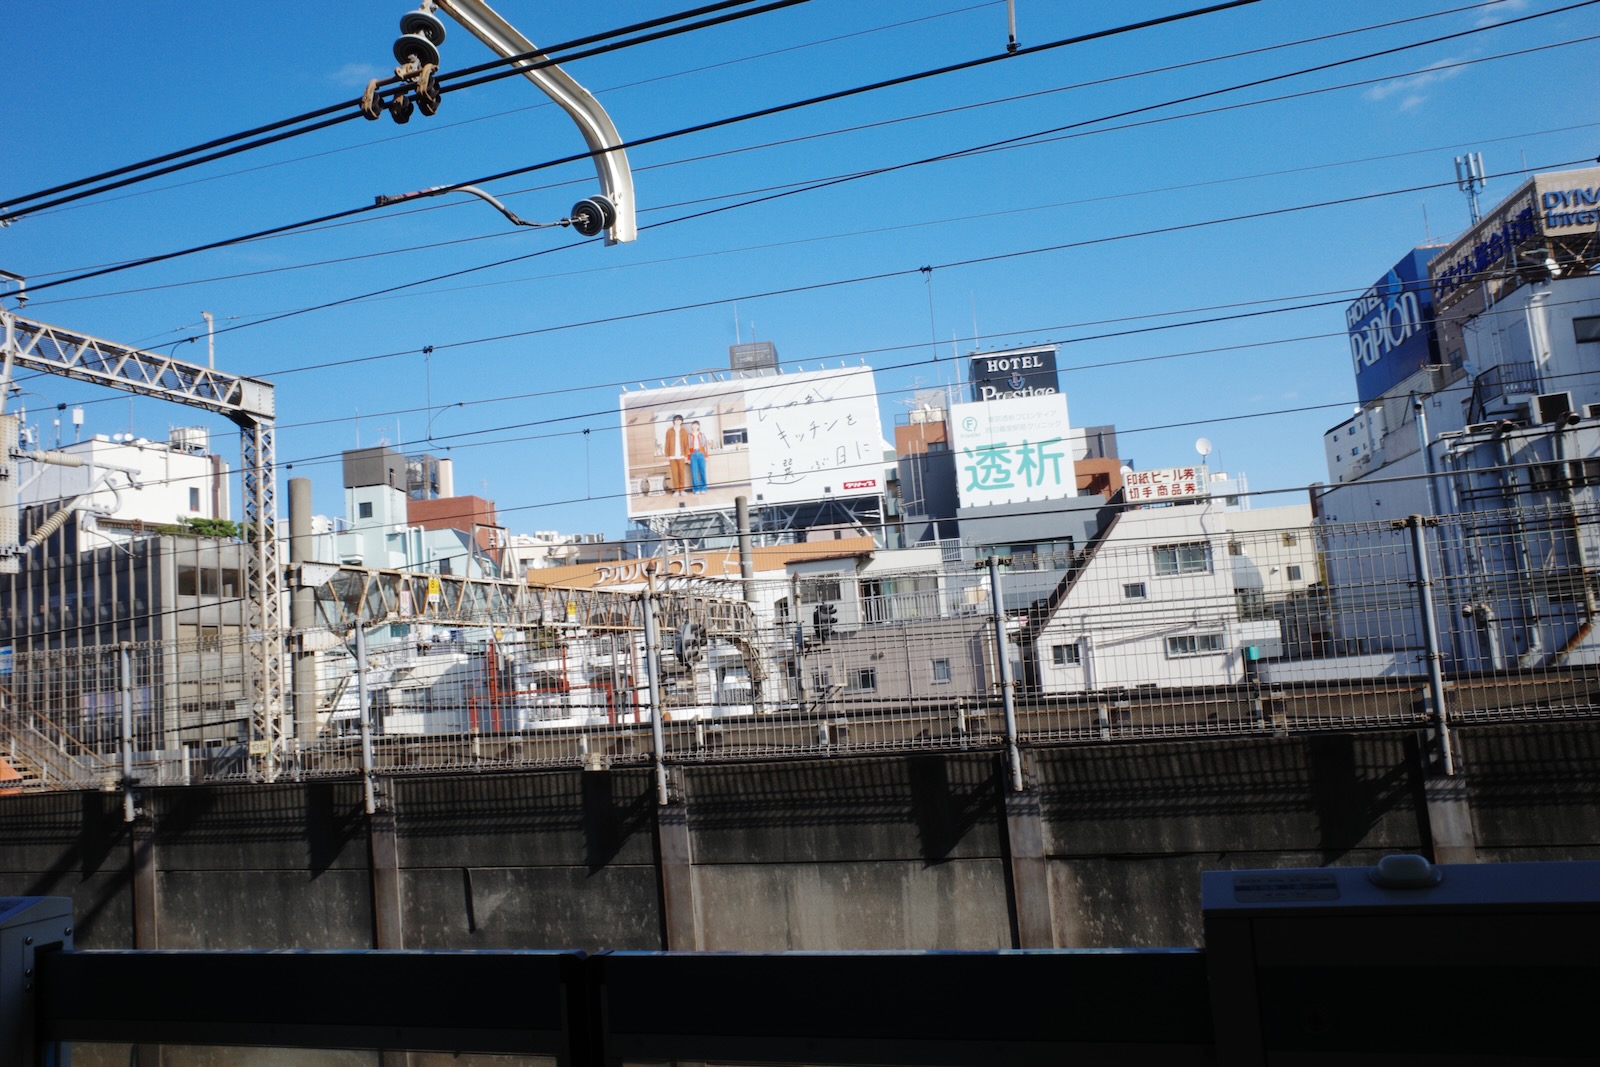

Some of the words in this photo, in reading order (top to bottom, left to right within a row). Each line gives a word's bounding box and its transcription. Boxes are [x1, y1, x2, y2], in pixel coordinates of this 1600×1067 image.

[1543, 186, 1600, 210] DYN
[1546, 205, 1600, 229] Inves
[1347, 287, 1382, 328] HOTEL
[987, 355, 1043, 372] HOTEL
[775, 413, 857, 449] キッチンを
[766, 440, 870, 485] 選ぶ日に
[963, 436, 1065, 493] 透析
[1126, 468, 1195, 486] 印紙ビール券
[1128, 483, 1197, 500] 切手商品券
